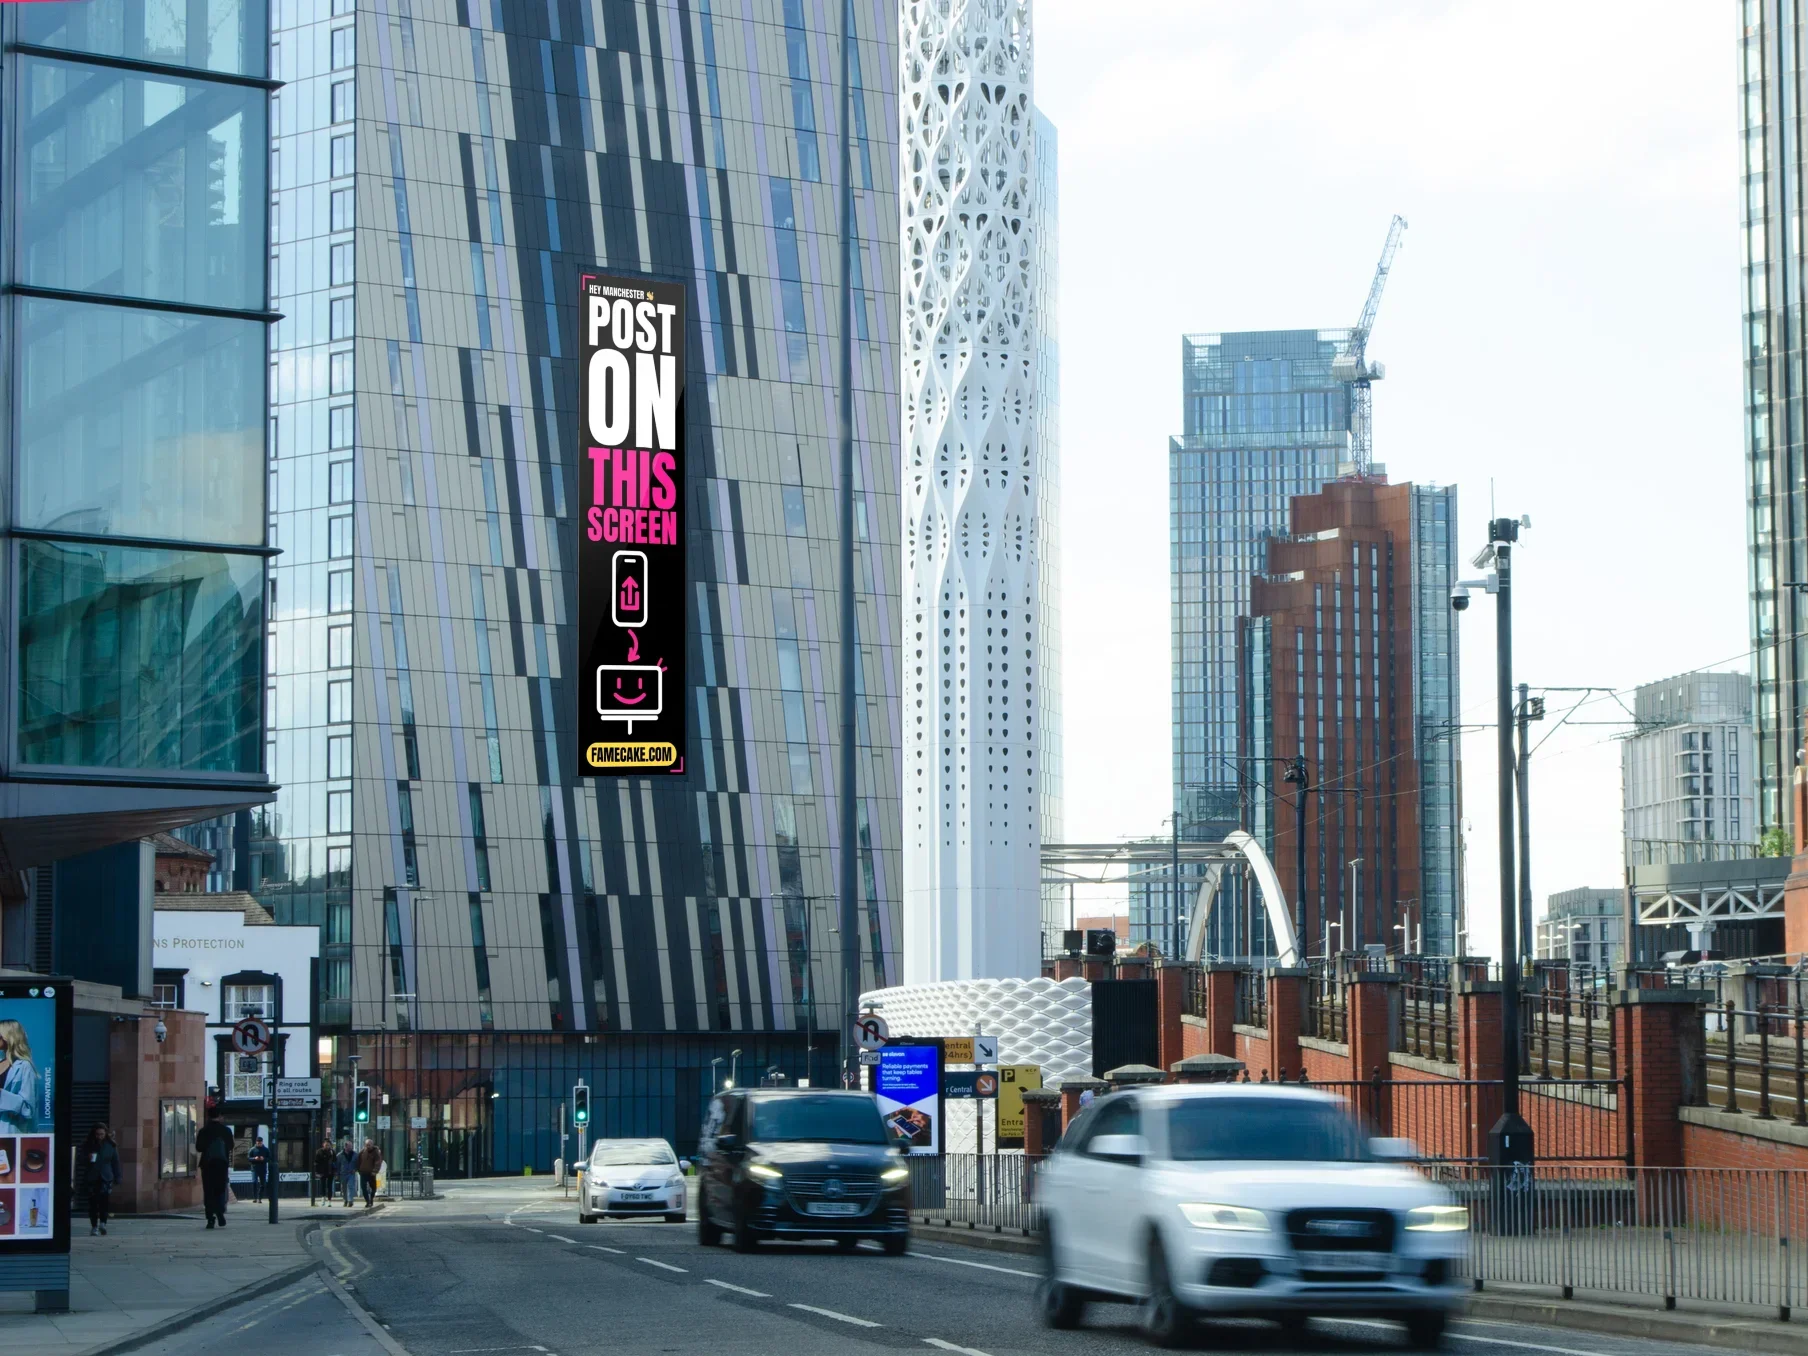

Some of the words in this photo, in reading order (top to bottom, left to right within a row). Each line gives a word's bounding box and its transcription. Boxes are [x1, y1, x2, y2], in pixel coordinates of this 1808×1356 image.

[589, 284, 601, 294] HEY
[603, 286, 644, 299] MANCHESTER
[588, 295, 676, 353] POST
[588, 348, 676, 450] ON
[588, 447, 676, 509] THIS
[587, 507, 677, 545] SCREEN
[591, 747, 672, 762] FAMECAKE.COM
[945, 1041, 971, 1049] entral
[949, 1085, 973, 1093] Central
